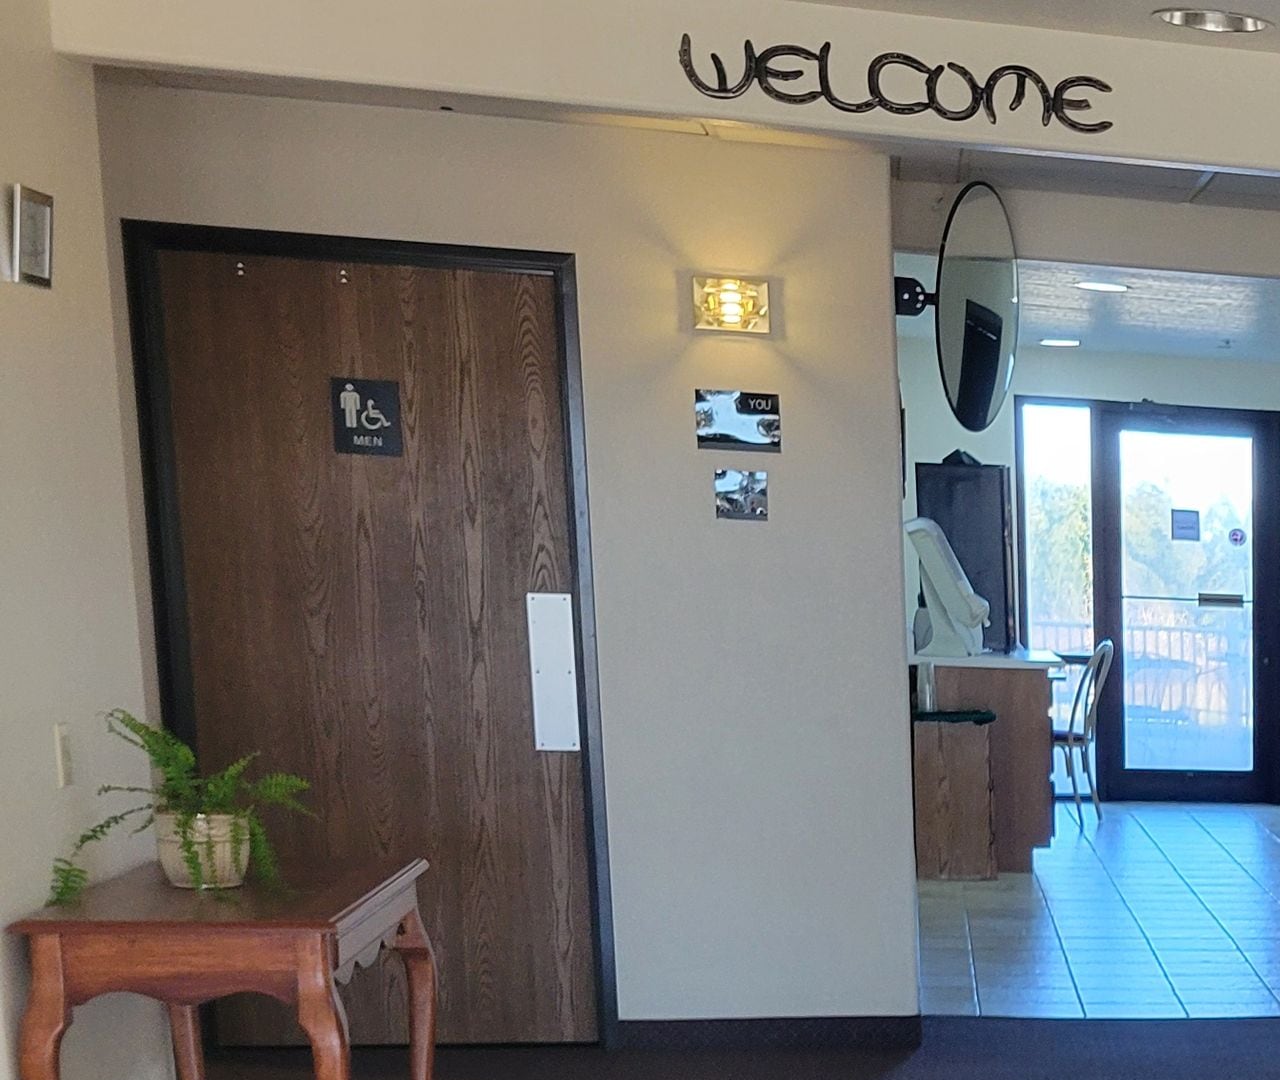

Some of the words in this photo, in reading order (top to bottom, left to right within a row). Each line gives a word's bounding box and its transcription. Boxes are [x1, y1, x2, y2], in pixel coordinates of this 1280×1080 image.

[679, 33, 1113, 134] WELCOME
[749, 399, 771, 410] YOU
[353, 435, 382, 446] MEN
